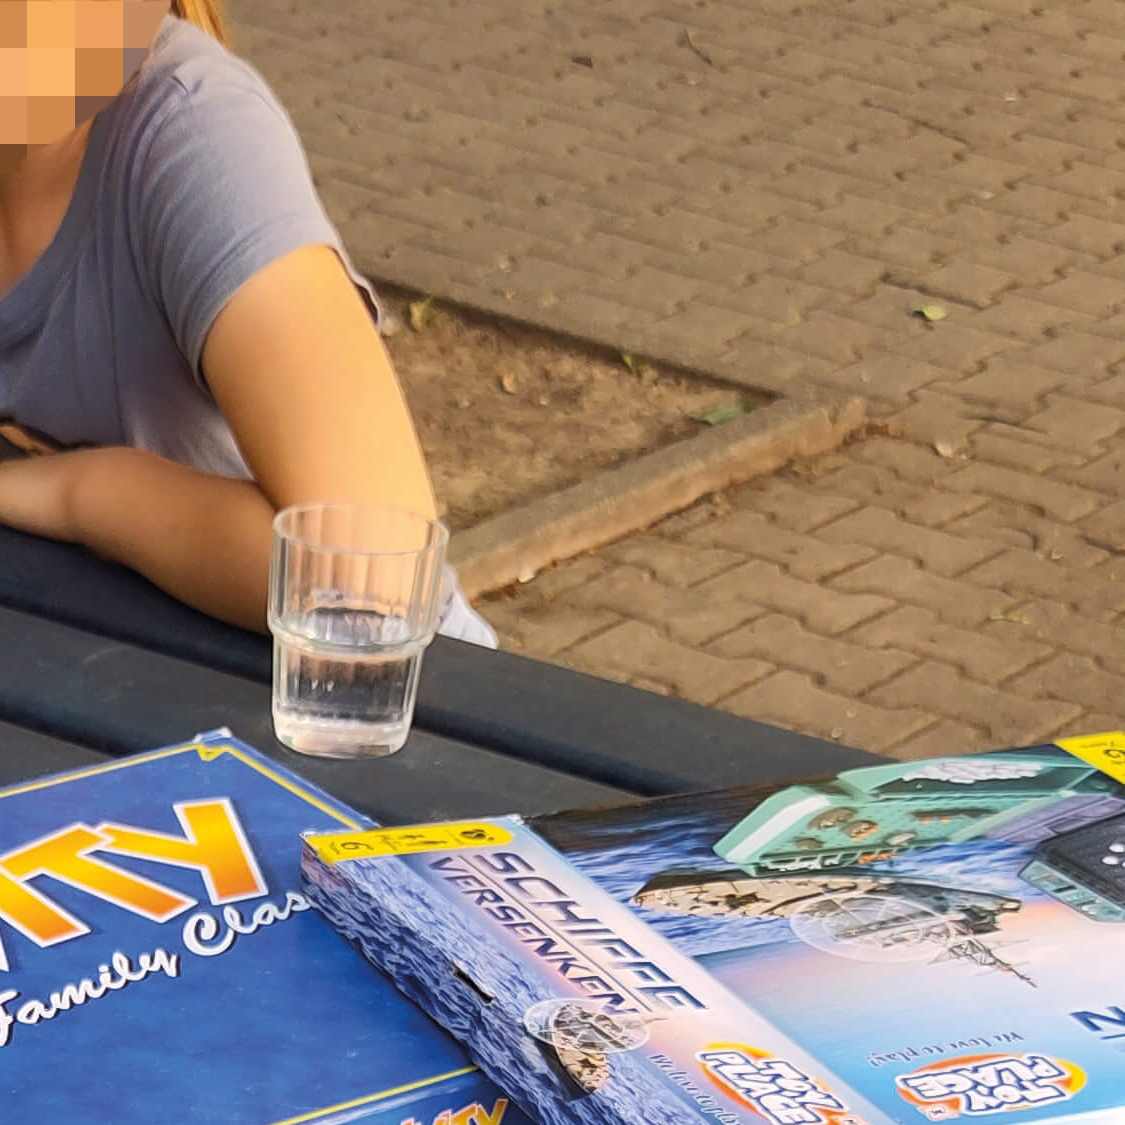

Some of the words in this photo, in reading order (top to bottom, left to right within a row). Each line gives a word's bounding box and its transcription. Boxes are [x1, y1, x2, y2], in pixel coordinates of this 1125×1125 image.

[182, 892, 312, 956] Clas
[427, 856, 639, 1016] VERSENKEN
[475, 851, 710, 1011] SCHIFFE
[697, 1051, 824, 1125] PLACE
[762, 1060, 844, 1111] TOY
[900, 1055, 1067, 1099] PLACE
[965, 1080, 1067, 1112] TOY
